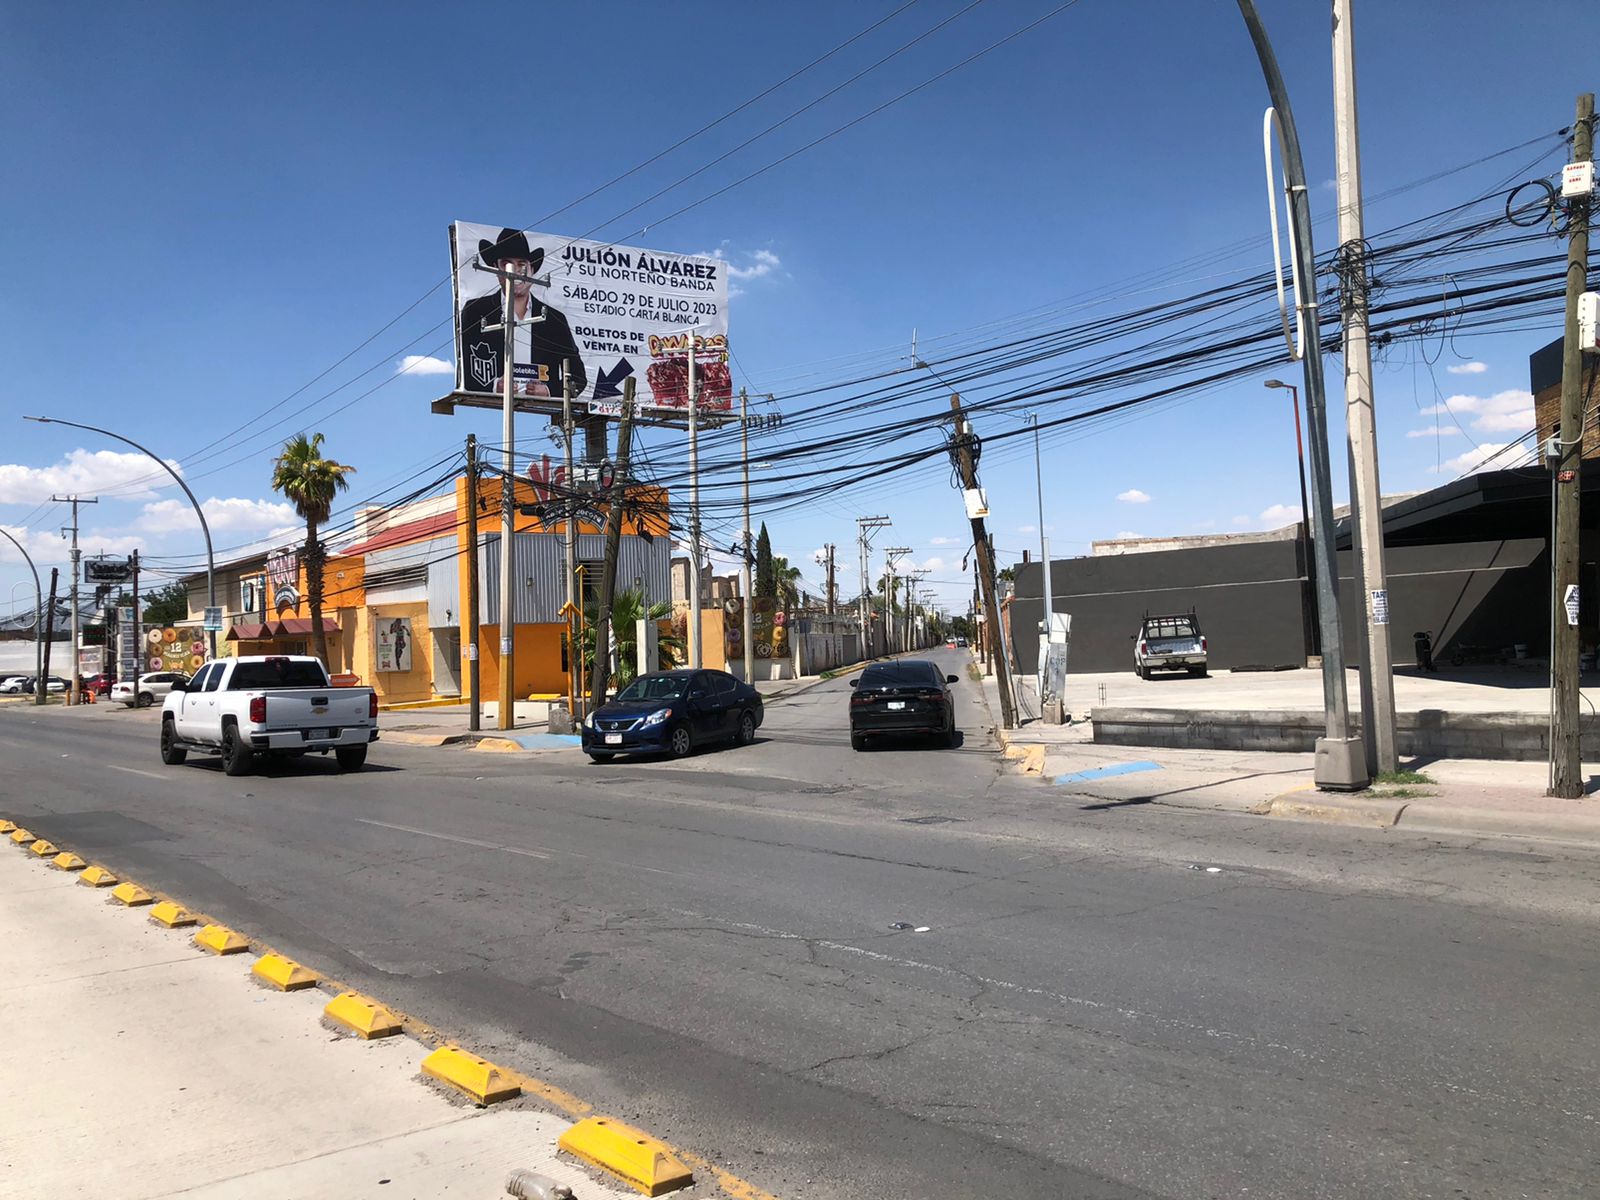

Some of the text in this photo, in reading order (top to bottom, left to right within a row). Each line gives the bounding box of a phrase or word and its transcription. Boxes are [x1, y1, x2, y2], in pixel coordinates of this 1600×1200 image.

[562, 245, 717, 280] JULIÓN ÁLVAREZ
[565, 262, 574, 276] Y
[579, 264, 596, 276] SU
[671, 278, 715, 292] BANDA
[563, 285, 717, 315] SÁBADO 29 DE JULIO 2023
[584, 303, 700, 325] ESTADIO CARTA BLANCA
[575, 326, 645, 342] BOLETOS DE
[583, 340, 621, 353] VENTA
[623, 345, 639, 355] EN
[170, 642, 182, 653] 12
